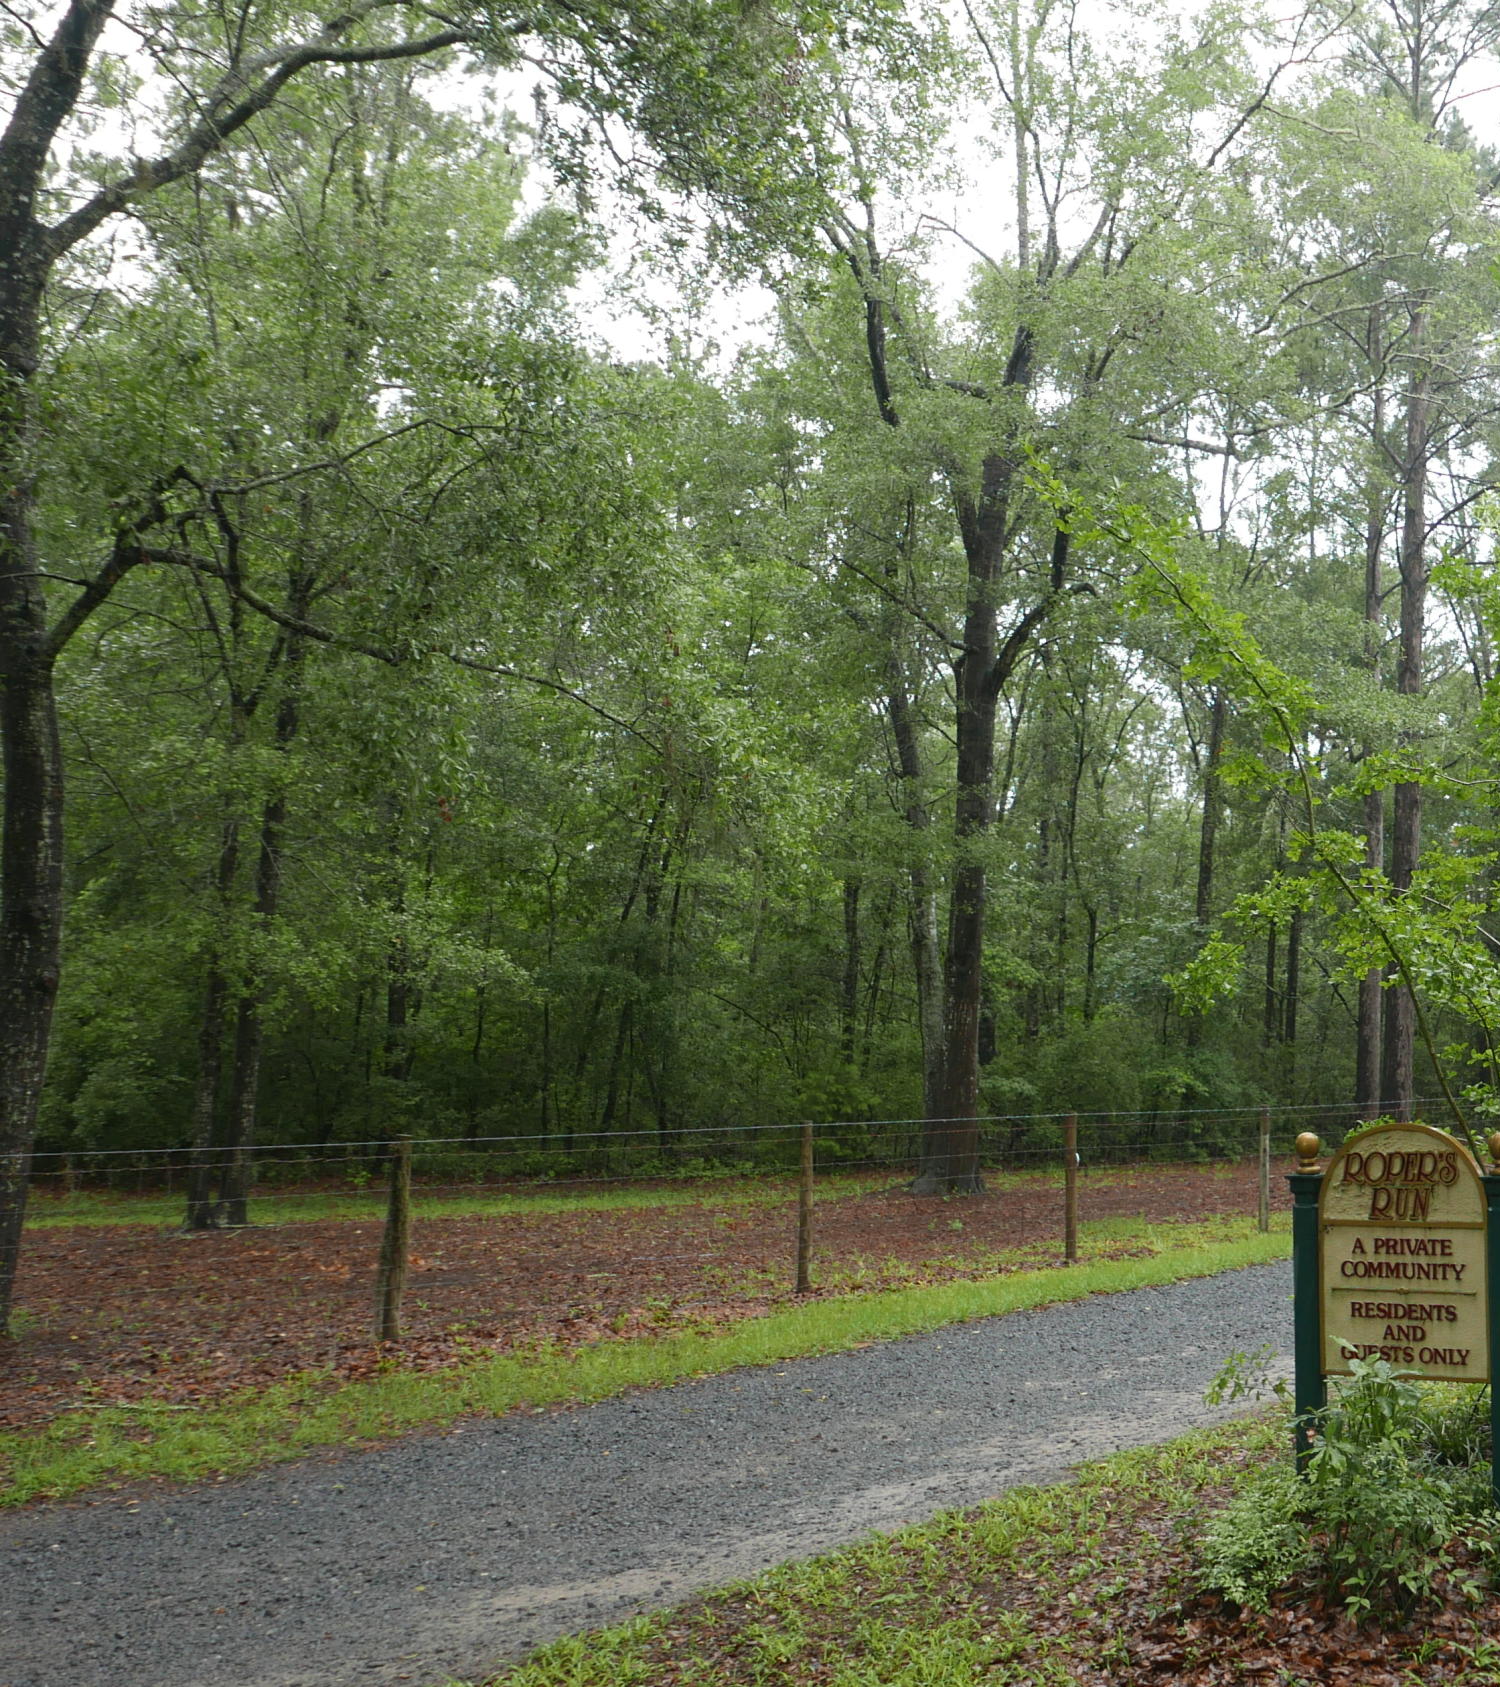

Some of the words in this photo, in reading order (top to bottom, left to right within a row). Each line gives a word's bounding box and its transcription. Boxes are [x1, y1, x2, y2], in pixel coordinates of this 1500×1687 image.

[1342, 1151, 1458, 1185] ROPER'S
[1369, 1186, 1431, 1220] RUN
[1352, 1238, 1366, 1254] A
[1374, 1238, 1453, 1256] PRIVATE
[1341, 1261, 1466, 1280] COMMUNITY
[1351, 1302, 1458, 1322] RESIDENTS
[1383, 1325, 1426, 1342] AND
[1419, 1347, 1470, 1366] ONLY
